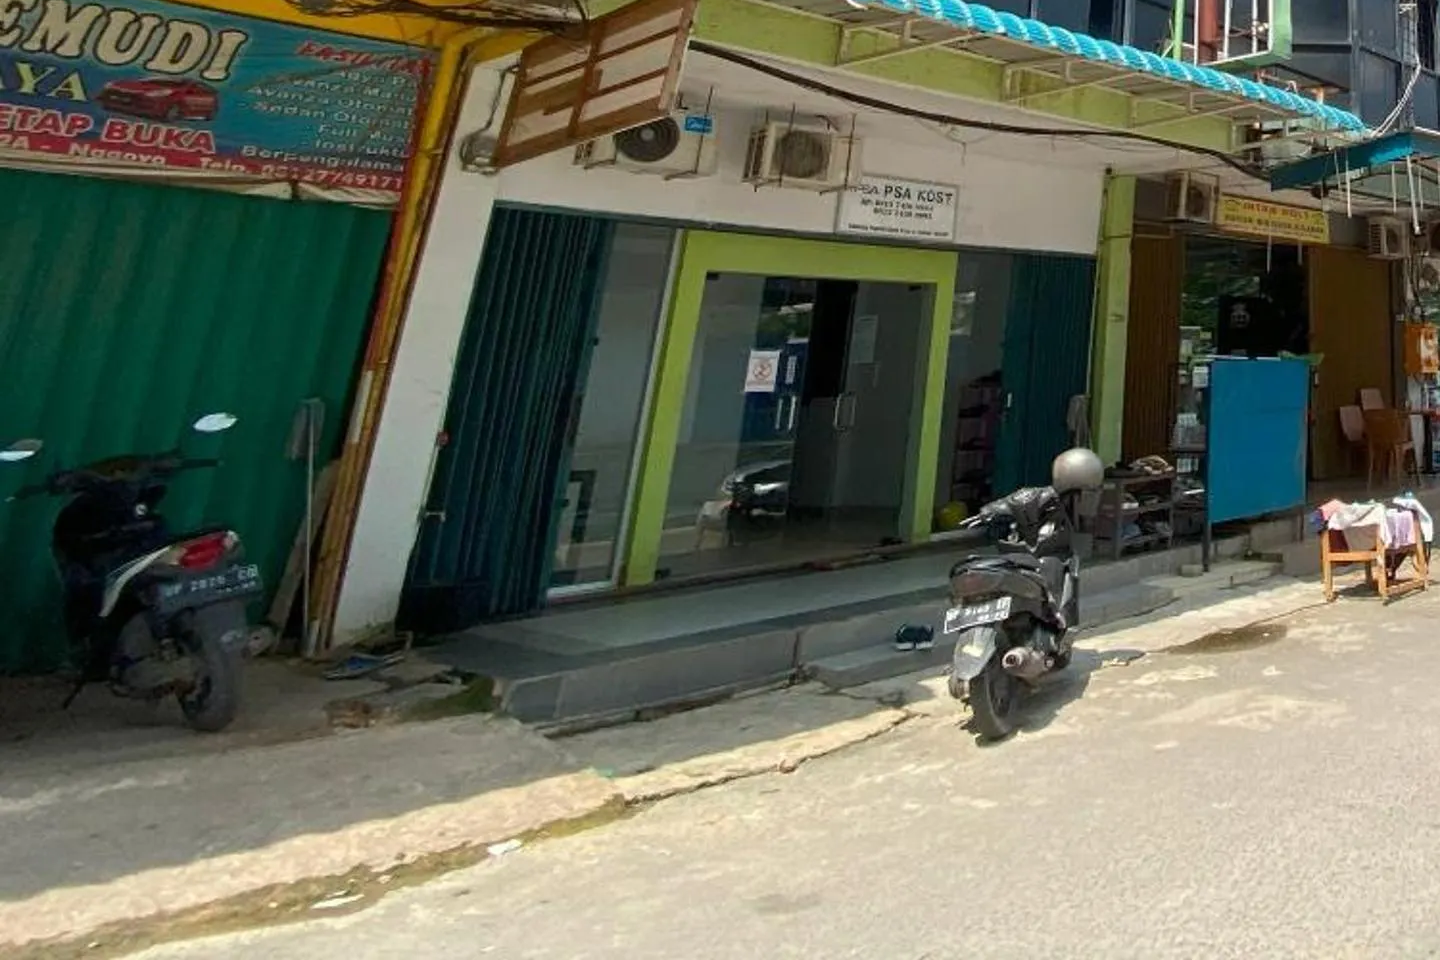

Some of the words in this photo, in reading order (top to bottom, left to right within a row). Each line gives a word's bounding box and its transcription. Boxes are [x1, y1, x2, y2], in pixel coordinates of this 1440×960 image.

[0, 60, 88, 102] YA
[101, 119, 216, 154] BUKA
[884, 185, 912, 200] PSA
[917, 189, 953, 205] KOST
